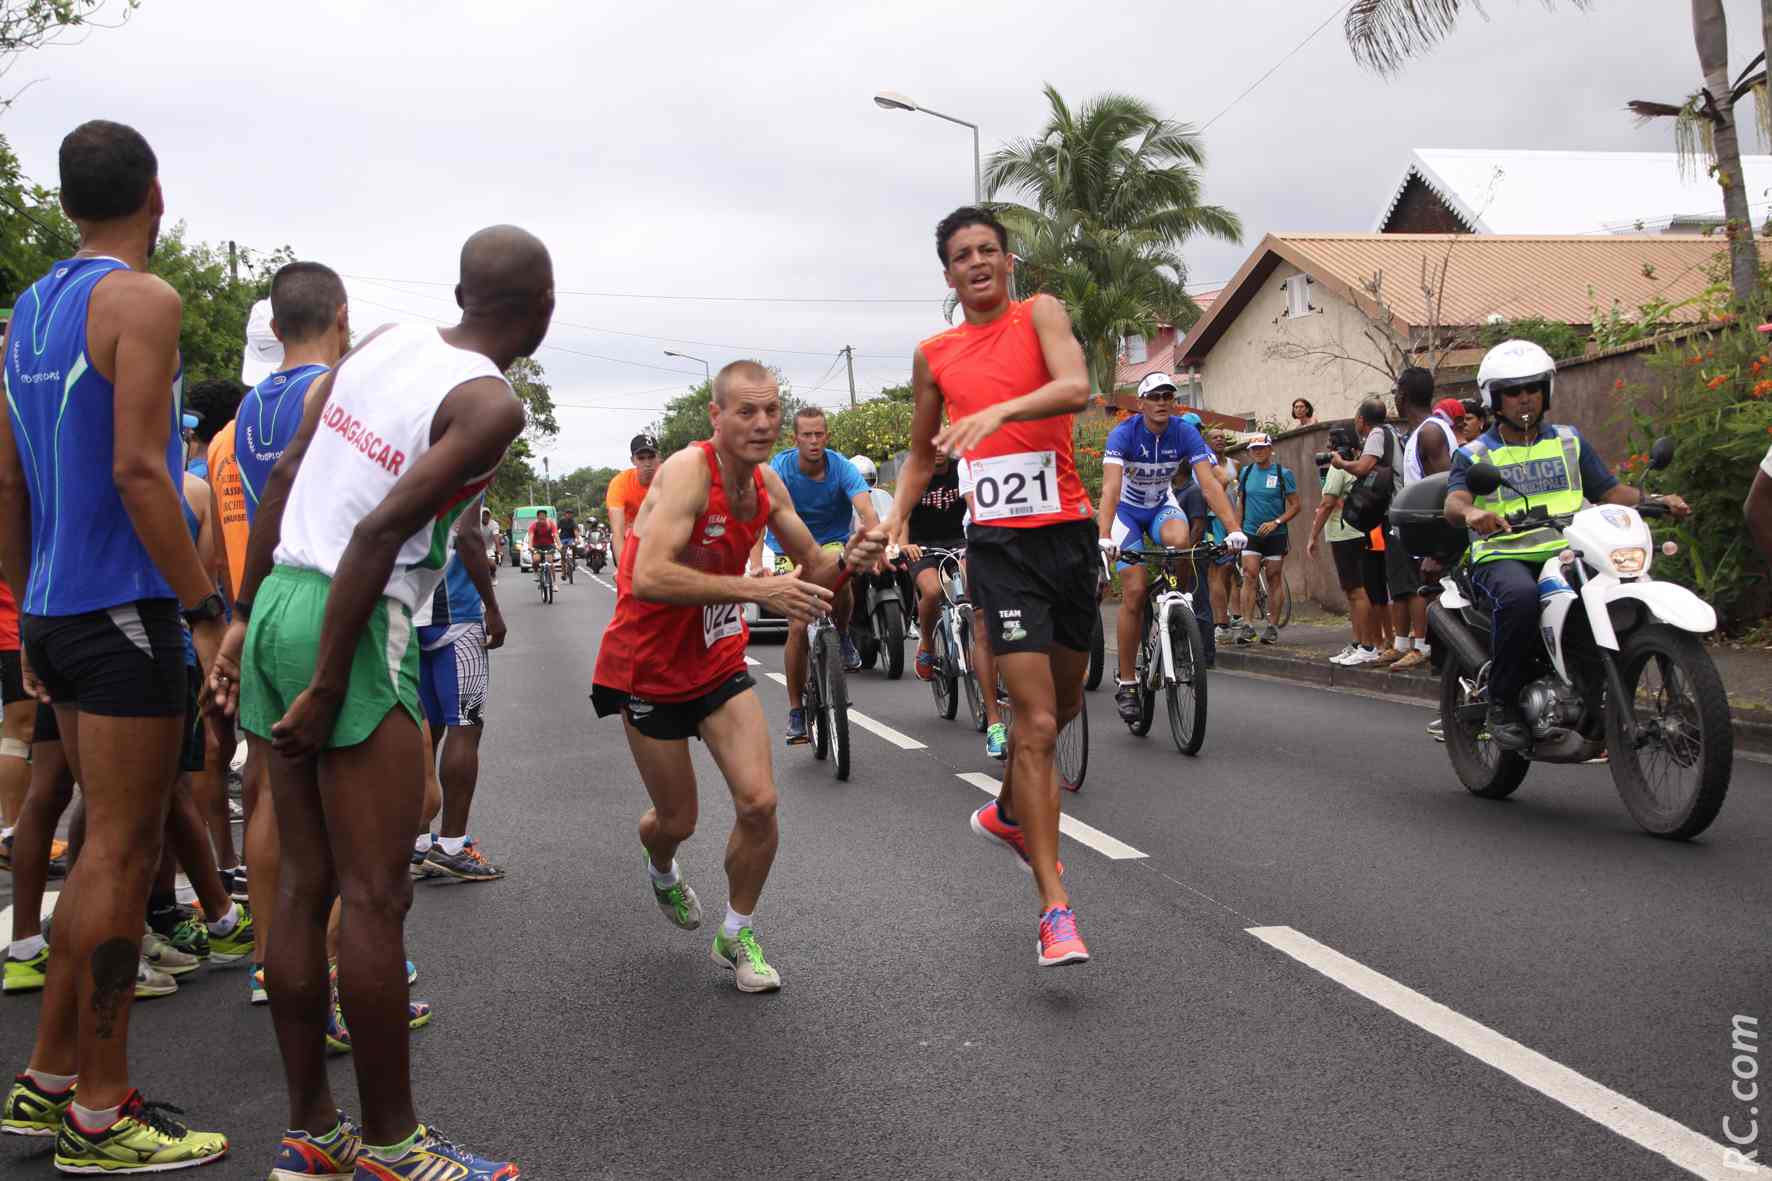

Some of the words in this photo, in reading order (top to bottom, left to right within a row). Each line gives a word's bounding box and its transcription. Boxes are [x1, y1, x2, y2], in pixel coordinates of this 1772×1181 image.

[320, 401, 406, 476] ADAGASCAR
[1499, 459, 1565, 484] POLICE
[975, 469, 1048, 509] 021
[708, 513, 728, 524] TEAM
[704, 603, 737, 635] 022
[998, 609, 1022, 618] TEAM
